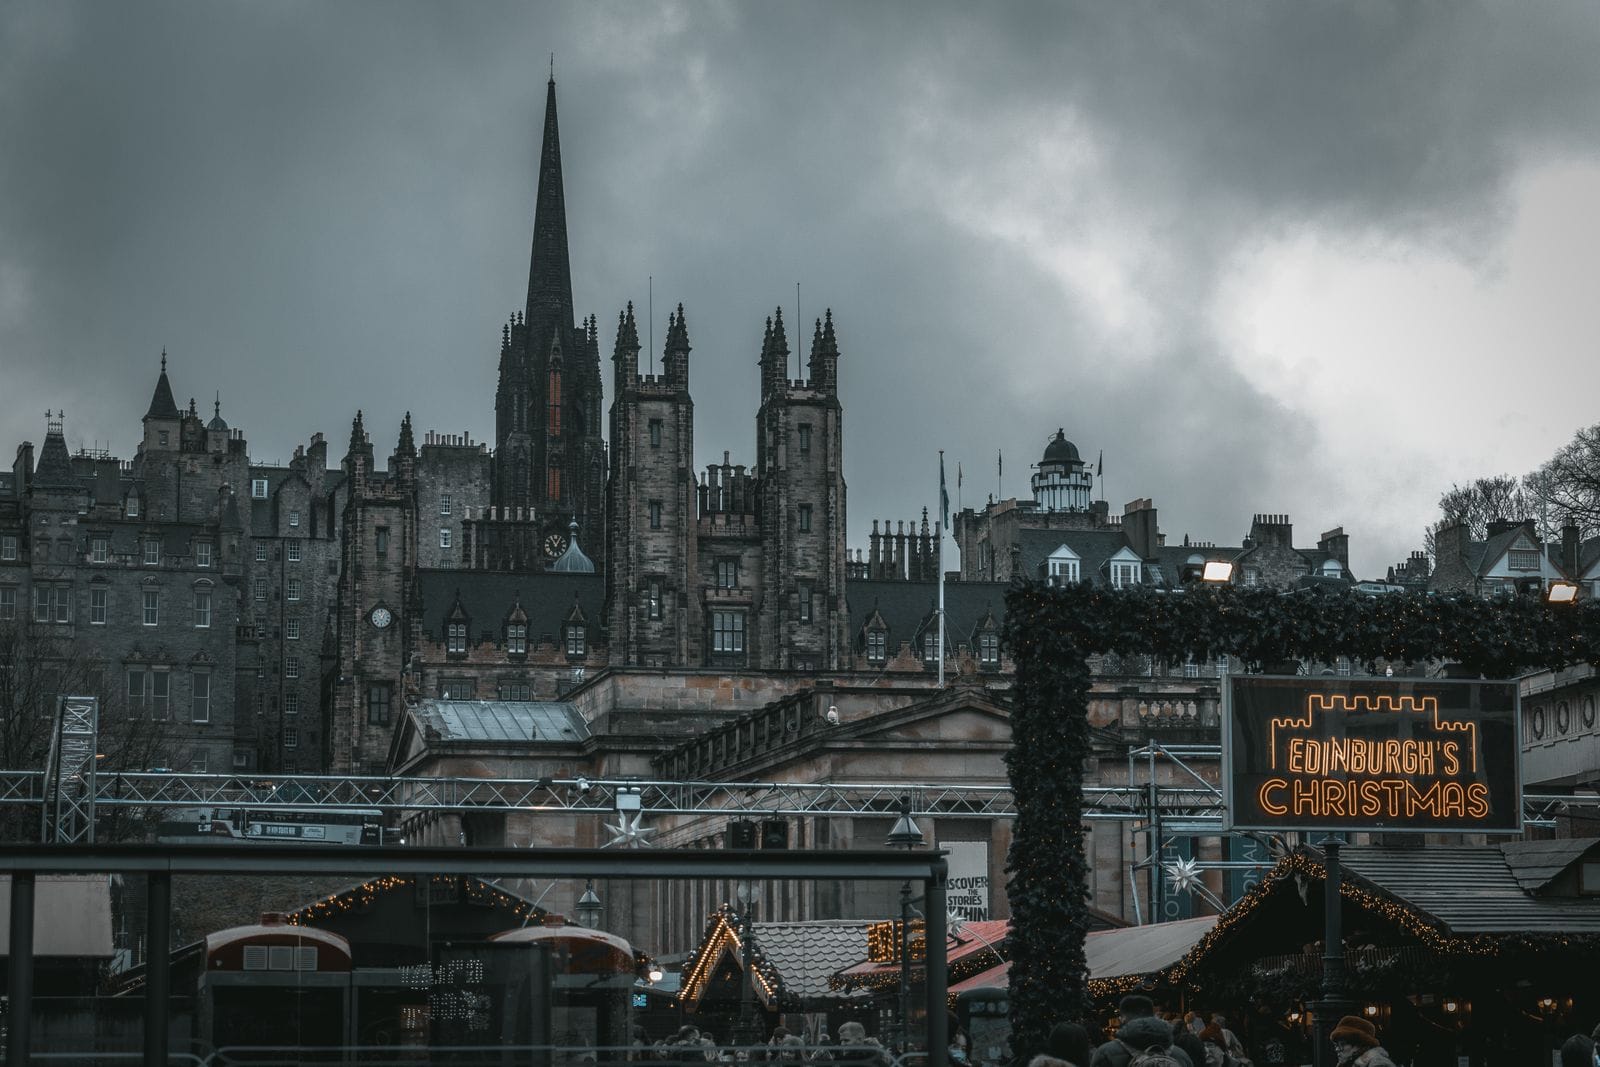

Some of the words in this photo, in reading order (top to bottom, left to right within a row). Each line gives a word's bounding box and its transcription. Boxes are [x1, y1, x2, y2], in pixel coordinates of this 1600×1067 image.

[1290, 737, 1459, 776] EDINBURGH'S
[1260, 779, 1488, 818] CHRISTMAS
[1242, 840, 1258, 893] ONAL
[946, 876, 989, 890] ISCOVER
[968, 888, 978, 896] THE
[948, 895, 982, 905] STORIES
